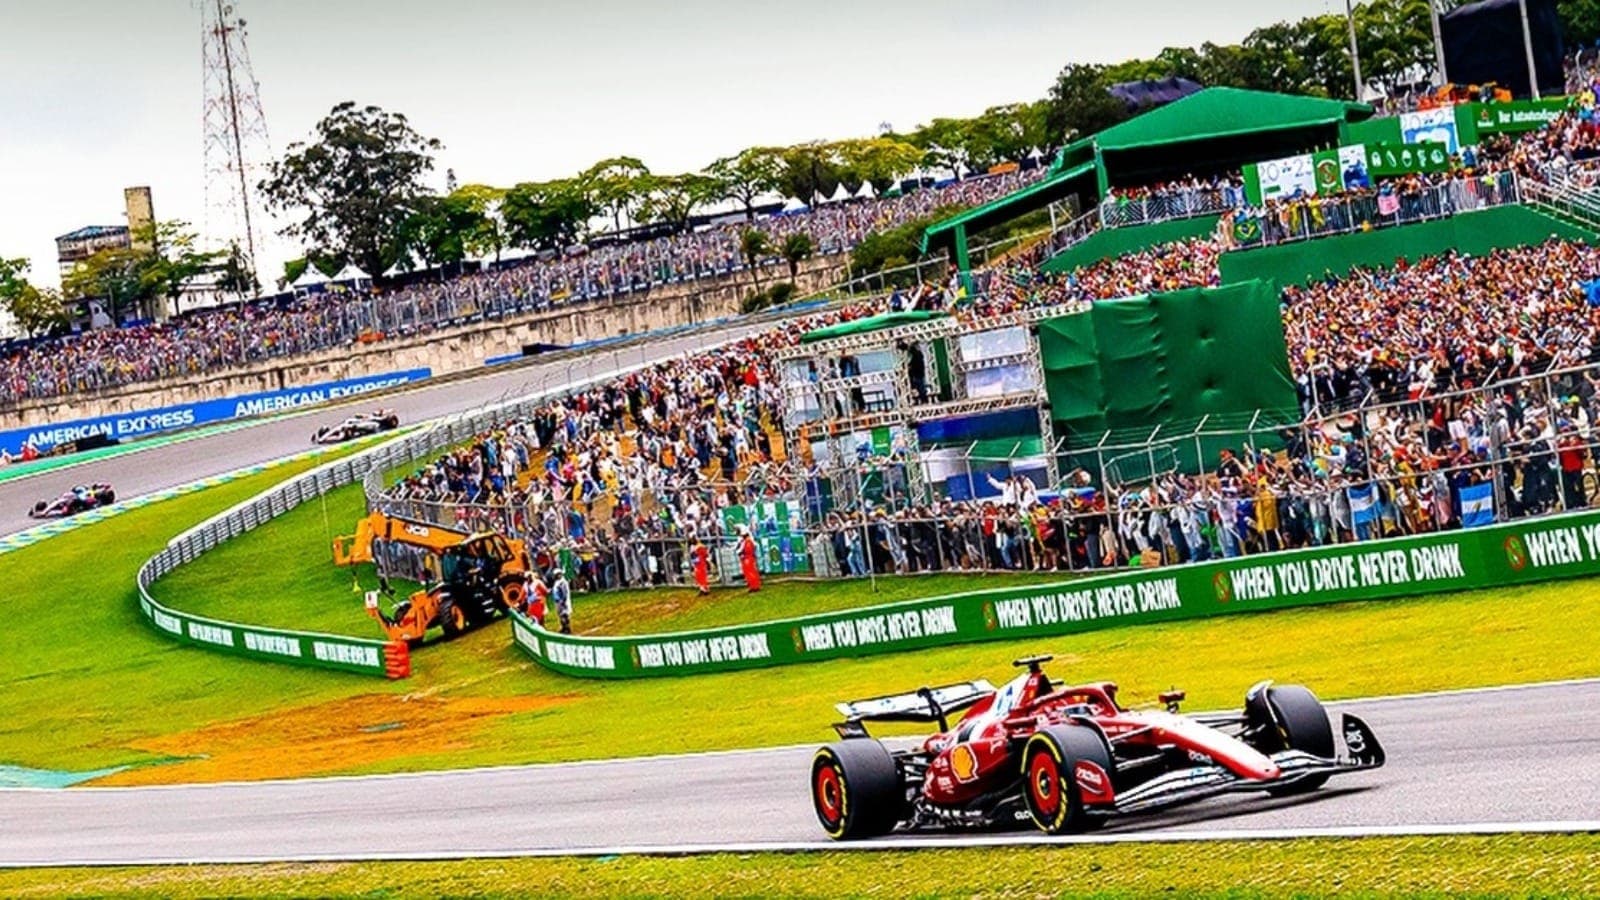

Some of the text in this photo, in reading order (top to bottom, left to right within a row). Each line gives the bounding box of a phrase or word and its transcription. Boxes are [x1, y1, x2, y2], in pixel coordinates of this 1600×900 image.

[235, 389, 324, 417] AMERICAN
[27, 421, 113, 446] AMERICAN
[405, 523, 429, 537] JCB
[1524, 526, 1583, 567] WHEN
[1230, 543, 1465, 601] WHEN YOU DRIVE NEVER DRINK
[995, 577, 1181, 629] WHEN YOU DRIVE NEVER DRINK
[801, 605, 957, 651] WHEN YOU DRIVE NEVER DRINK
